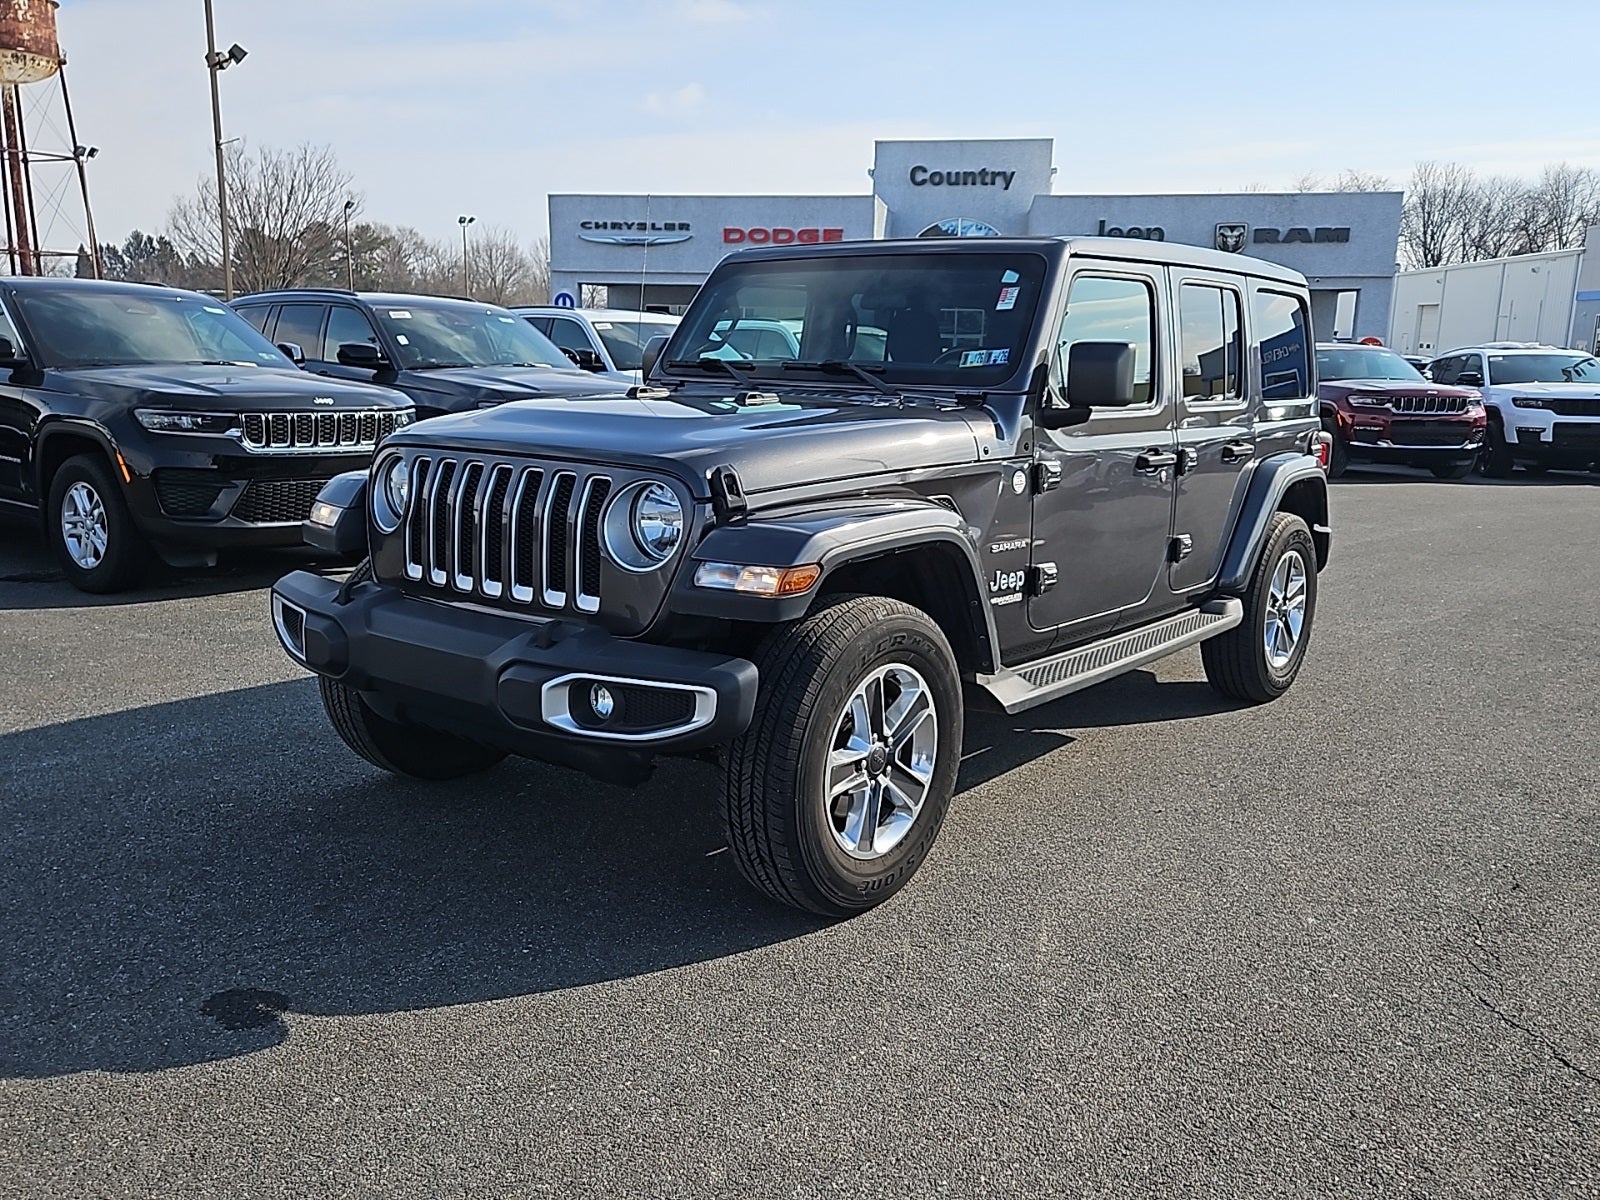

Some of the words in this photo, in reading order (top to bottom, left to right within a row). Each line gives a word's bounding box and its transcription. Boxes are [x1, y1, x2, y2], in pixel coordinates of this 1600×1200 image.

[909, 165, 1017, 191] Country
[580, 220, 692, 232] CHRYSLER
[723, 228, 844, 244] DODGE
[1252, 227, 1351, 244] RAM
[989, 570, 1025, 592] Jeep
